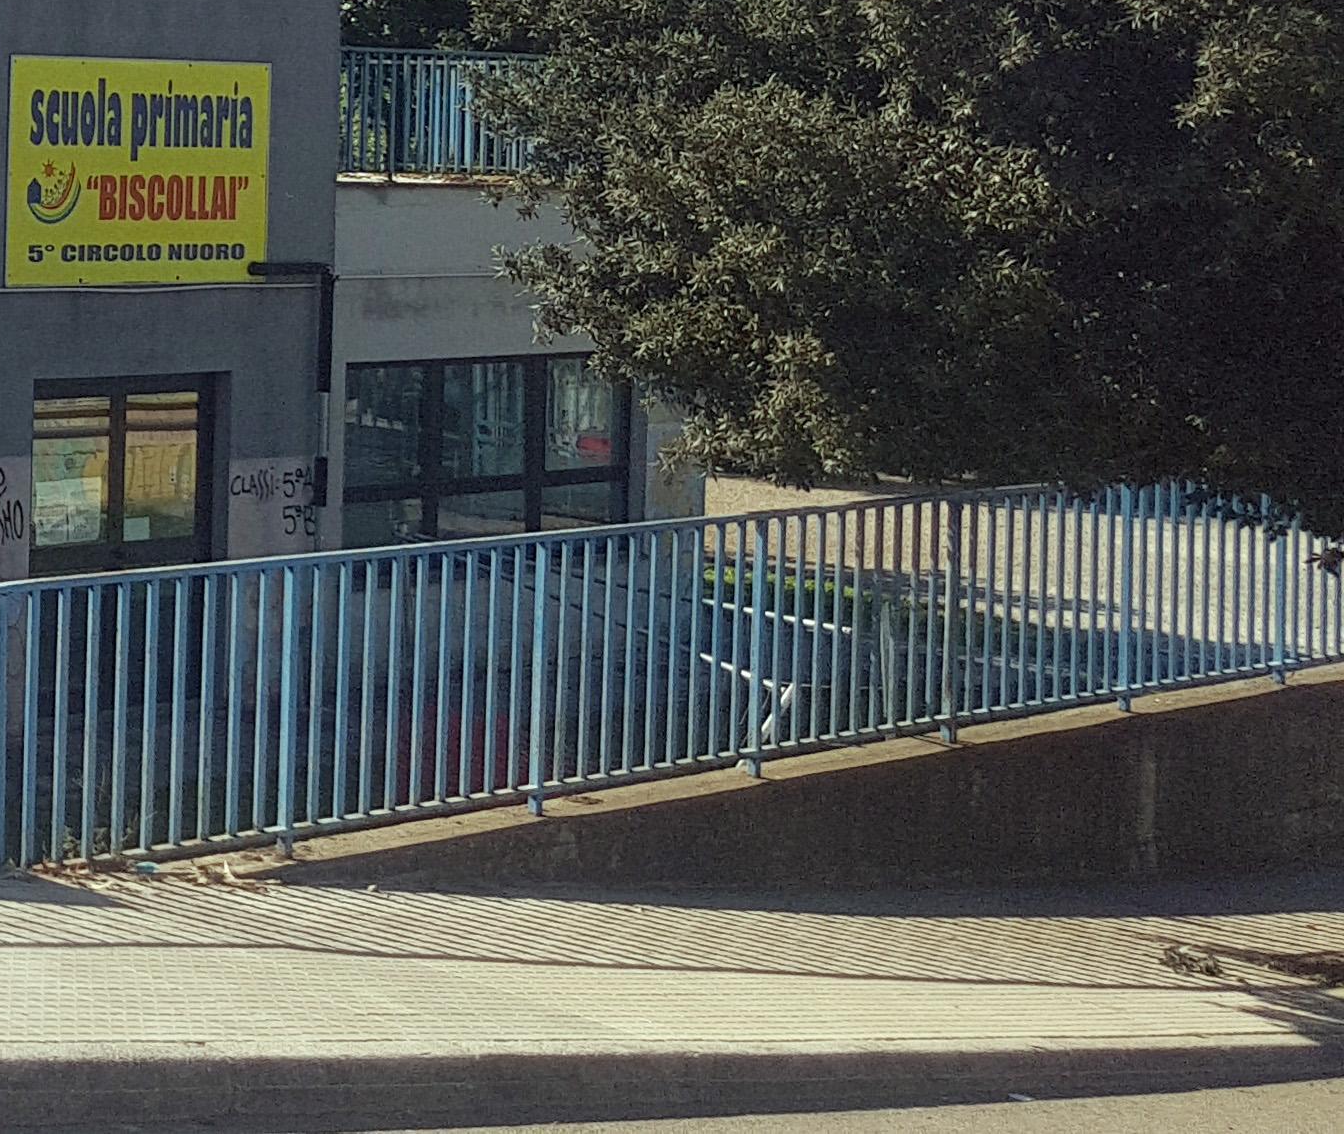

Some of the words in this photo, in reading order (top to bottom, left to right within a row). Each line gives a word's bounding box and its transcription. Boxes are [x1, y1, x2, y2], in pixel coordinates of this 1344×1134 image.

[29, 77, 122, 147] scuola
[130, 79, 253, 162] primaria
[86, 174, 250, 221] “BISCOLLAI”
[61, 243, 162, 262] CIRCOLO
[167, 242, 245, 261] NUORO
